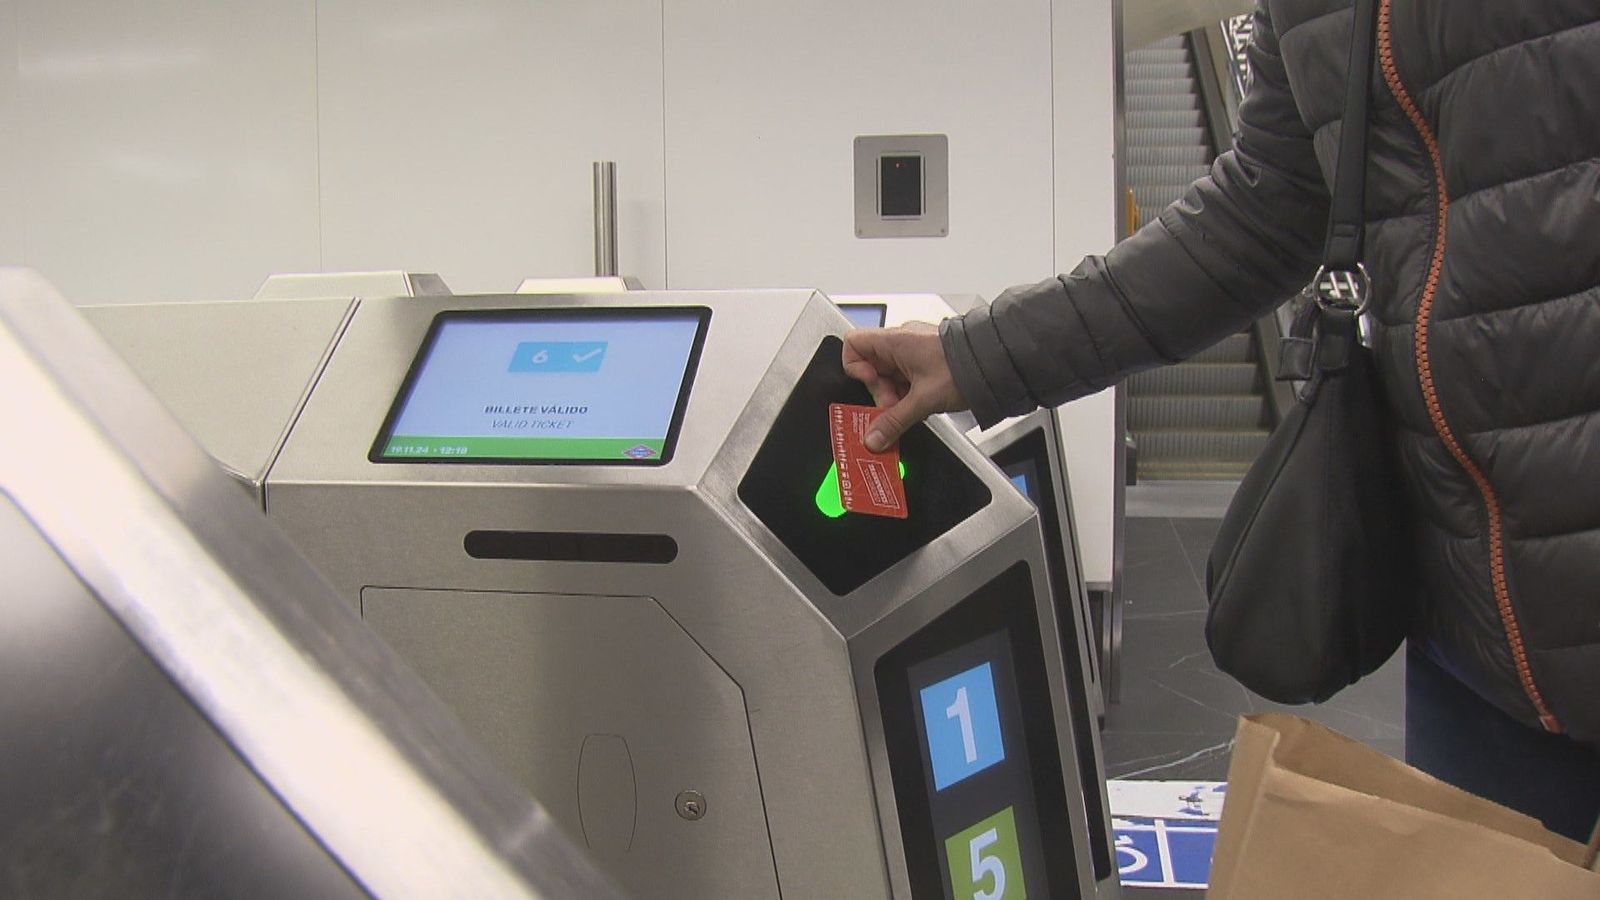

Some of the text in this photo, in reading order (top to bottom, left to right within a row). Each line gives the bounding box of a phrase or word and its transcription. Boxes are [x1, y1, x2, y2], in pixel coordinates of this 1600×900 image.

[531, 349, 549, 364] 6
[484, 405, 538, 415] BILLETE
[491, 419, 576, 429] VALID TICKET
[946, 686, 977, 764] 1
[969, 828, 1006, 900] 5
